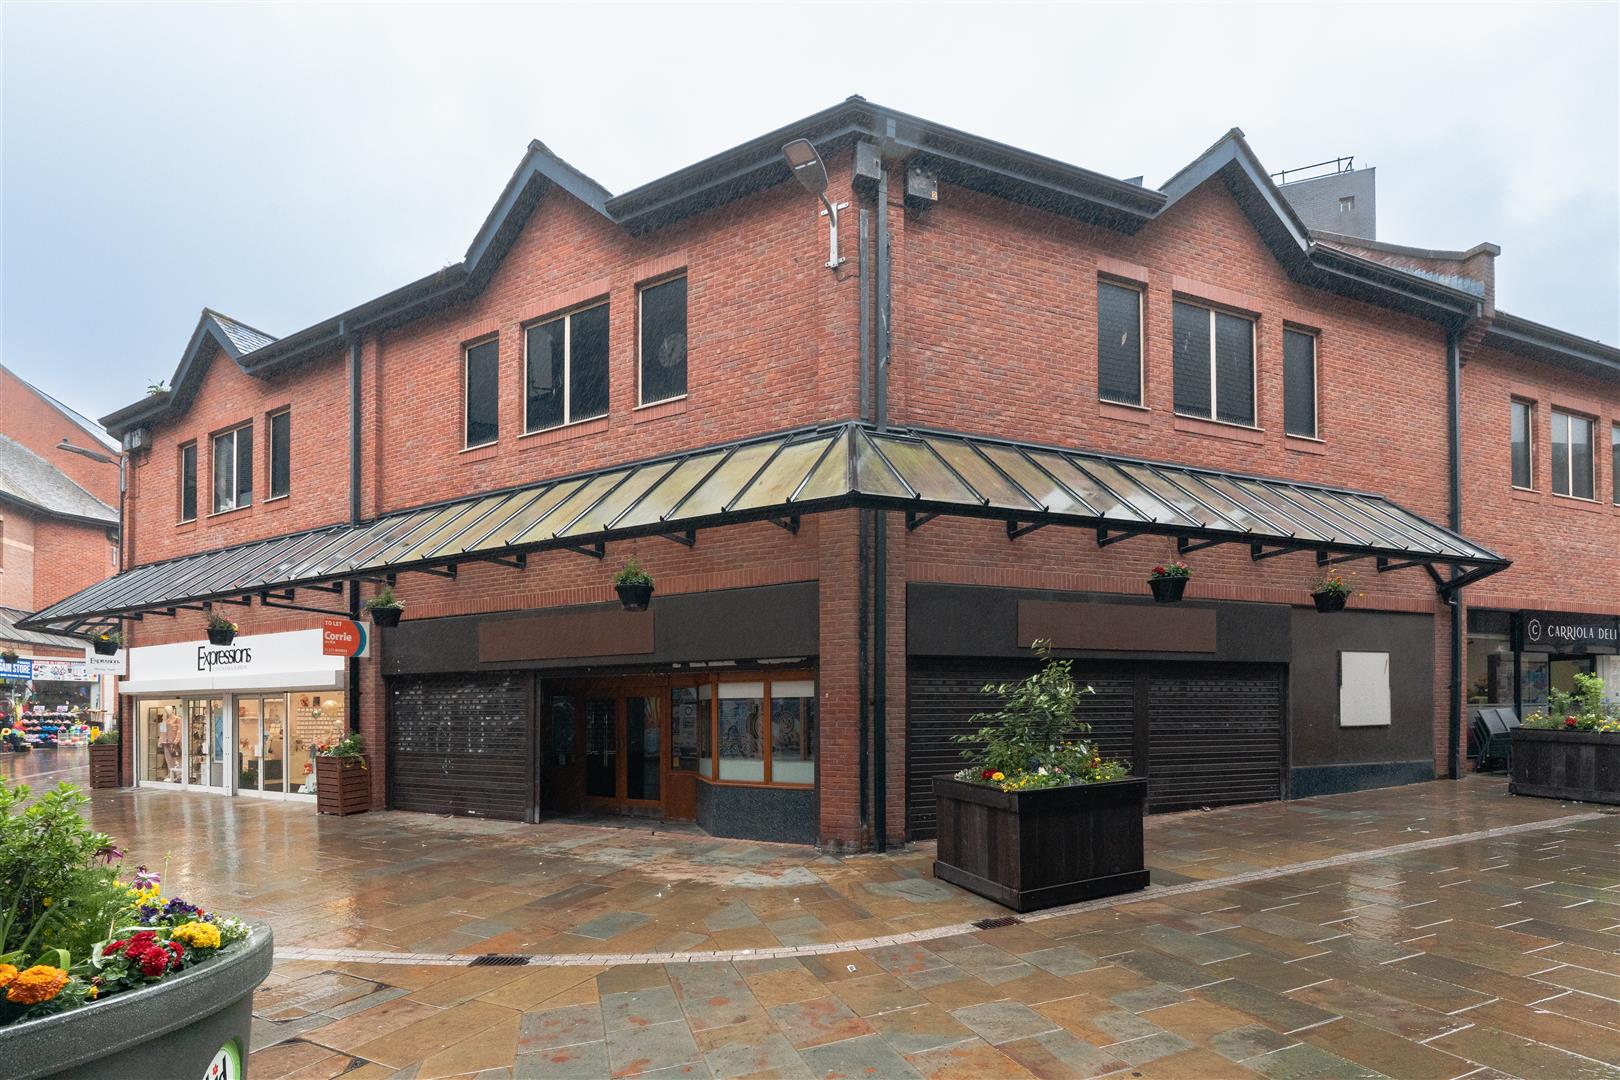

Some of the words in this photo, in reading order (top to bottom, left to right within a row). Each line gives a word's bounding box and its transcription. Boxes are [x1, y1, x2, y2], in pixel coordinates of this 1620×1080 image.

[324, 631, 353, 642] Corrie
[1547, 625, 1594, 641] CARRIOLA
[1598, 628, 1617, 640] DELI
[197, 643, 252, 672] Expressions
[13, 664, 30, 674] STORE
